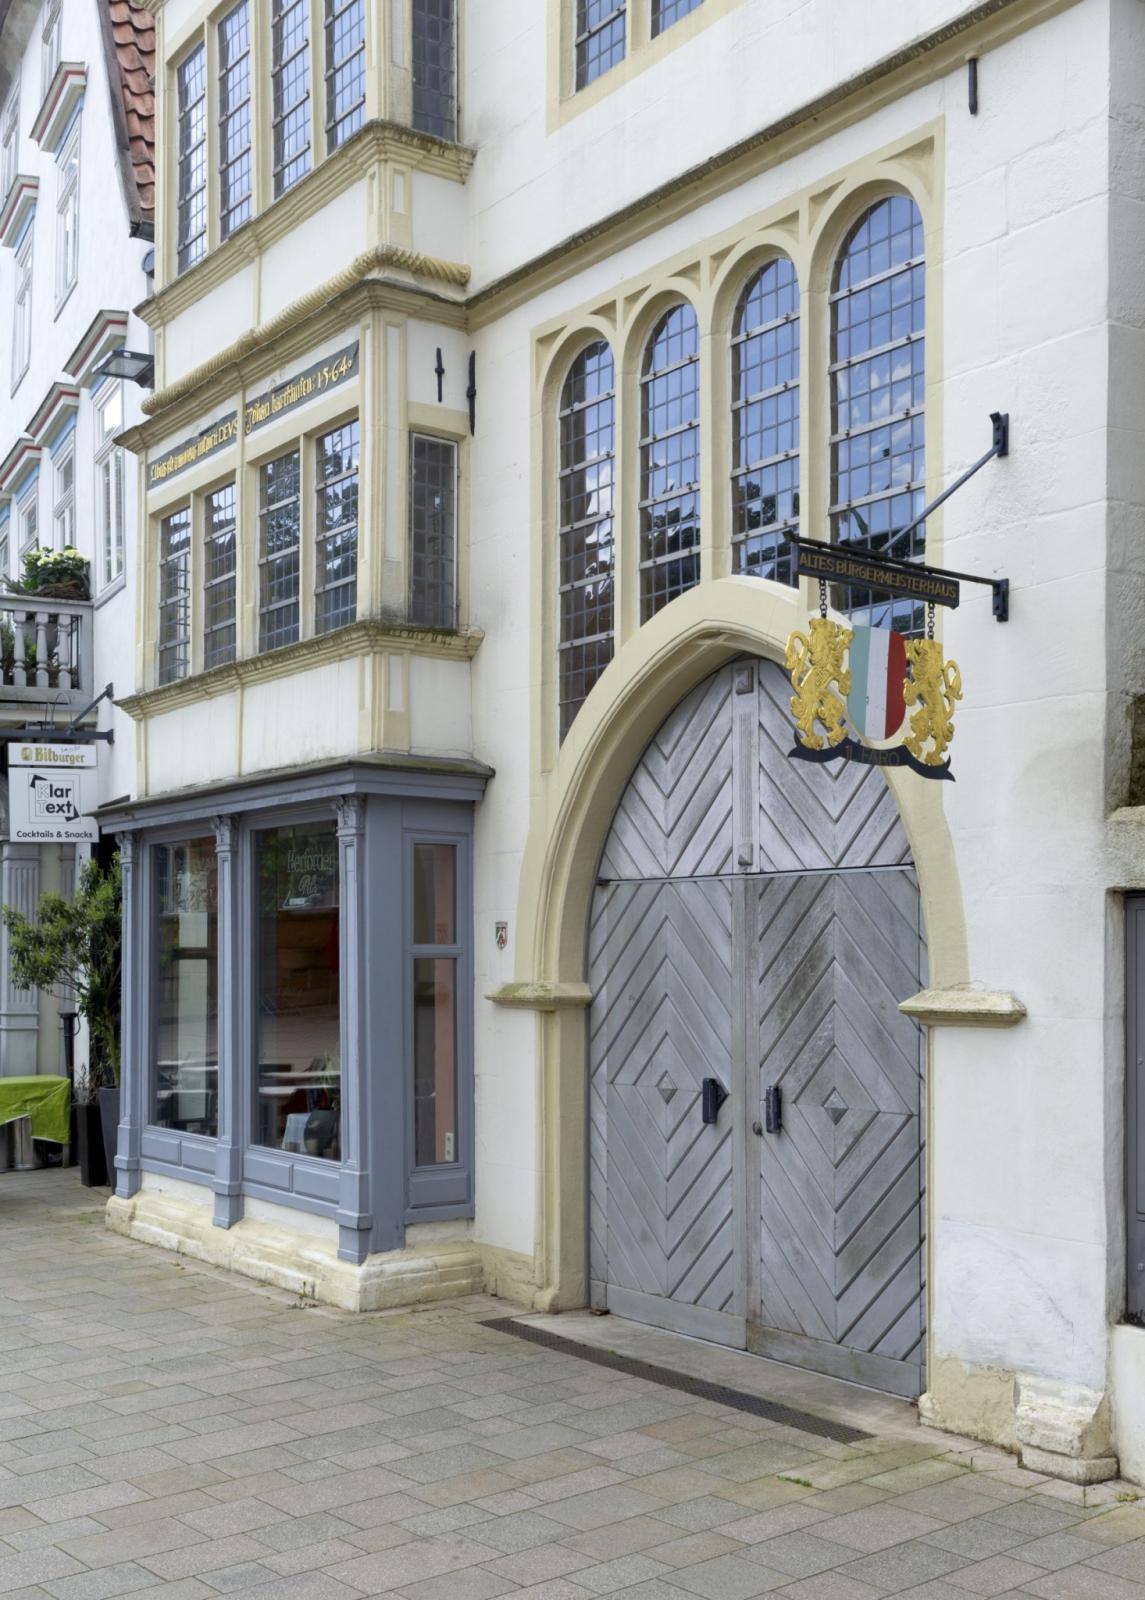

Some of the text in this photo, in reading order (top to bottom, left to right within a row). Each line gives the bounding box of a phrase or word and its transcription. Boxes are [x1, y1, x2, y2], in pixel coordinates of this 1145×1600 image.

[800, 552, 834, 572] ALTES
[35, 747, 85, 764] Bitburger
[16, 830, 93, 839] Cocktails & Snacks
